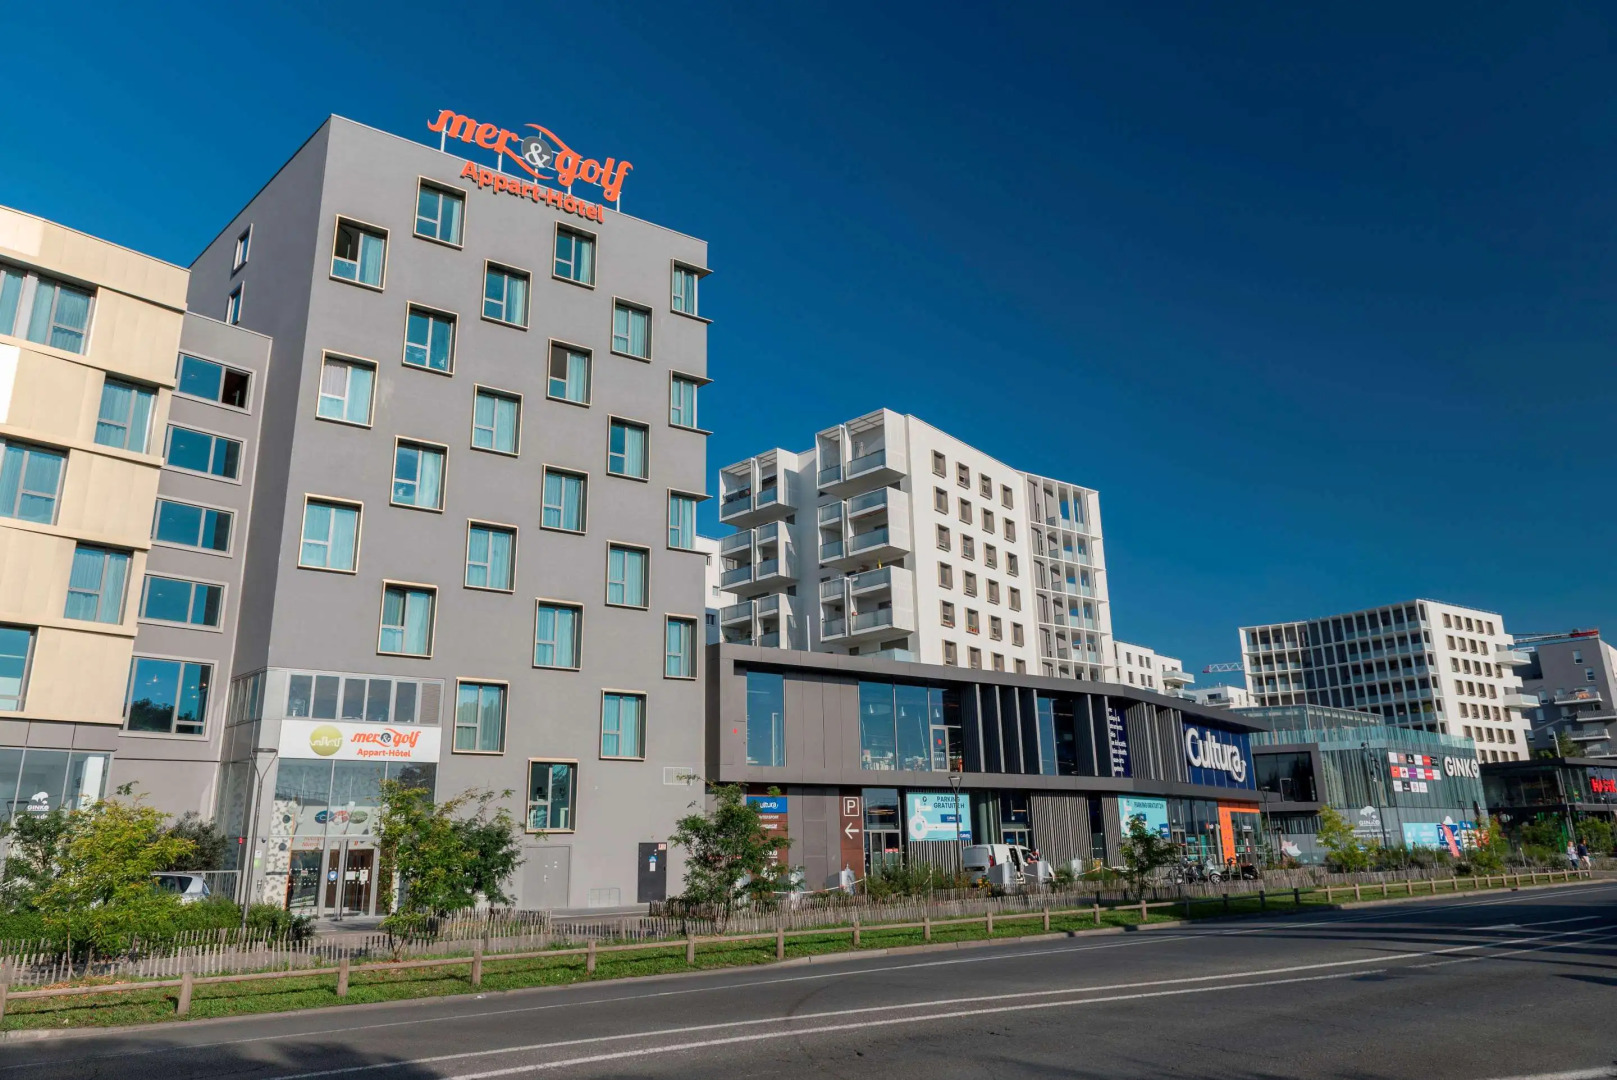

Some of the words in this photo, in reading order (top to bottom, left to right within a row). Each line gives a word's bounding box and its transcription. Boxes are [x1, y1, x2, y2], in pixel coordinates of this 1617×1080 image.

[523, 138, 550, 168] &
[460, 160, 605, 222] Appart-Hôtel
[381, 733, 391, 743] &
[384, 728, 421, 748] golf
[357, 748, 411, 757] Appart-Hôtel
[1185, 727, 1246, 783] Cultura
[1444, 756, 1479, 778] GINKO
[847, 800, 856, 813] P
